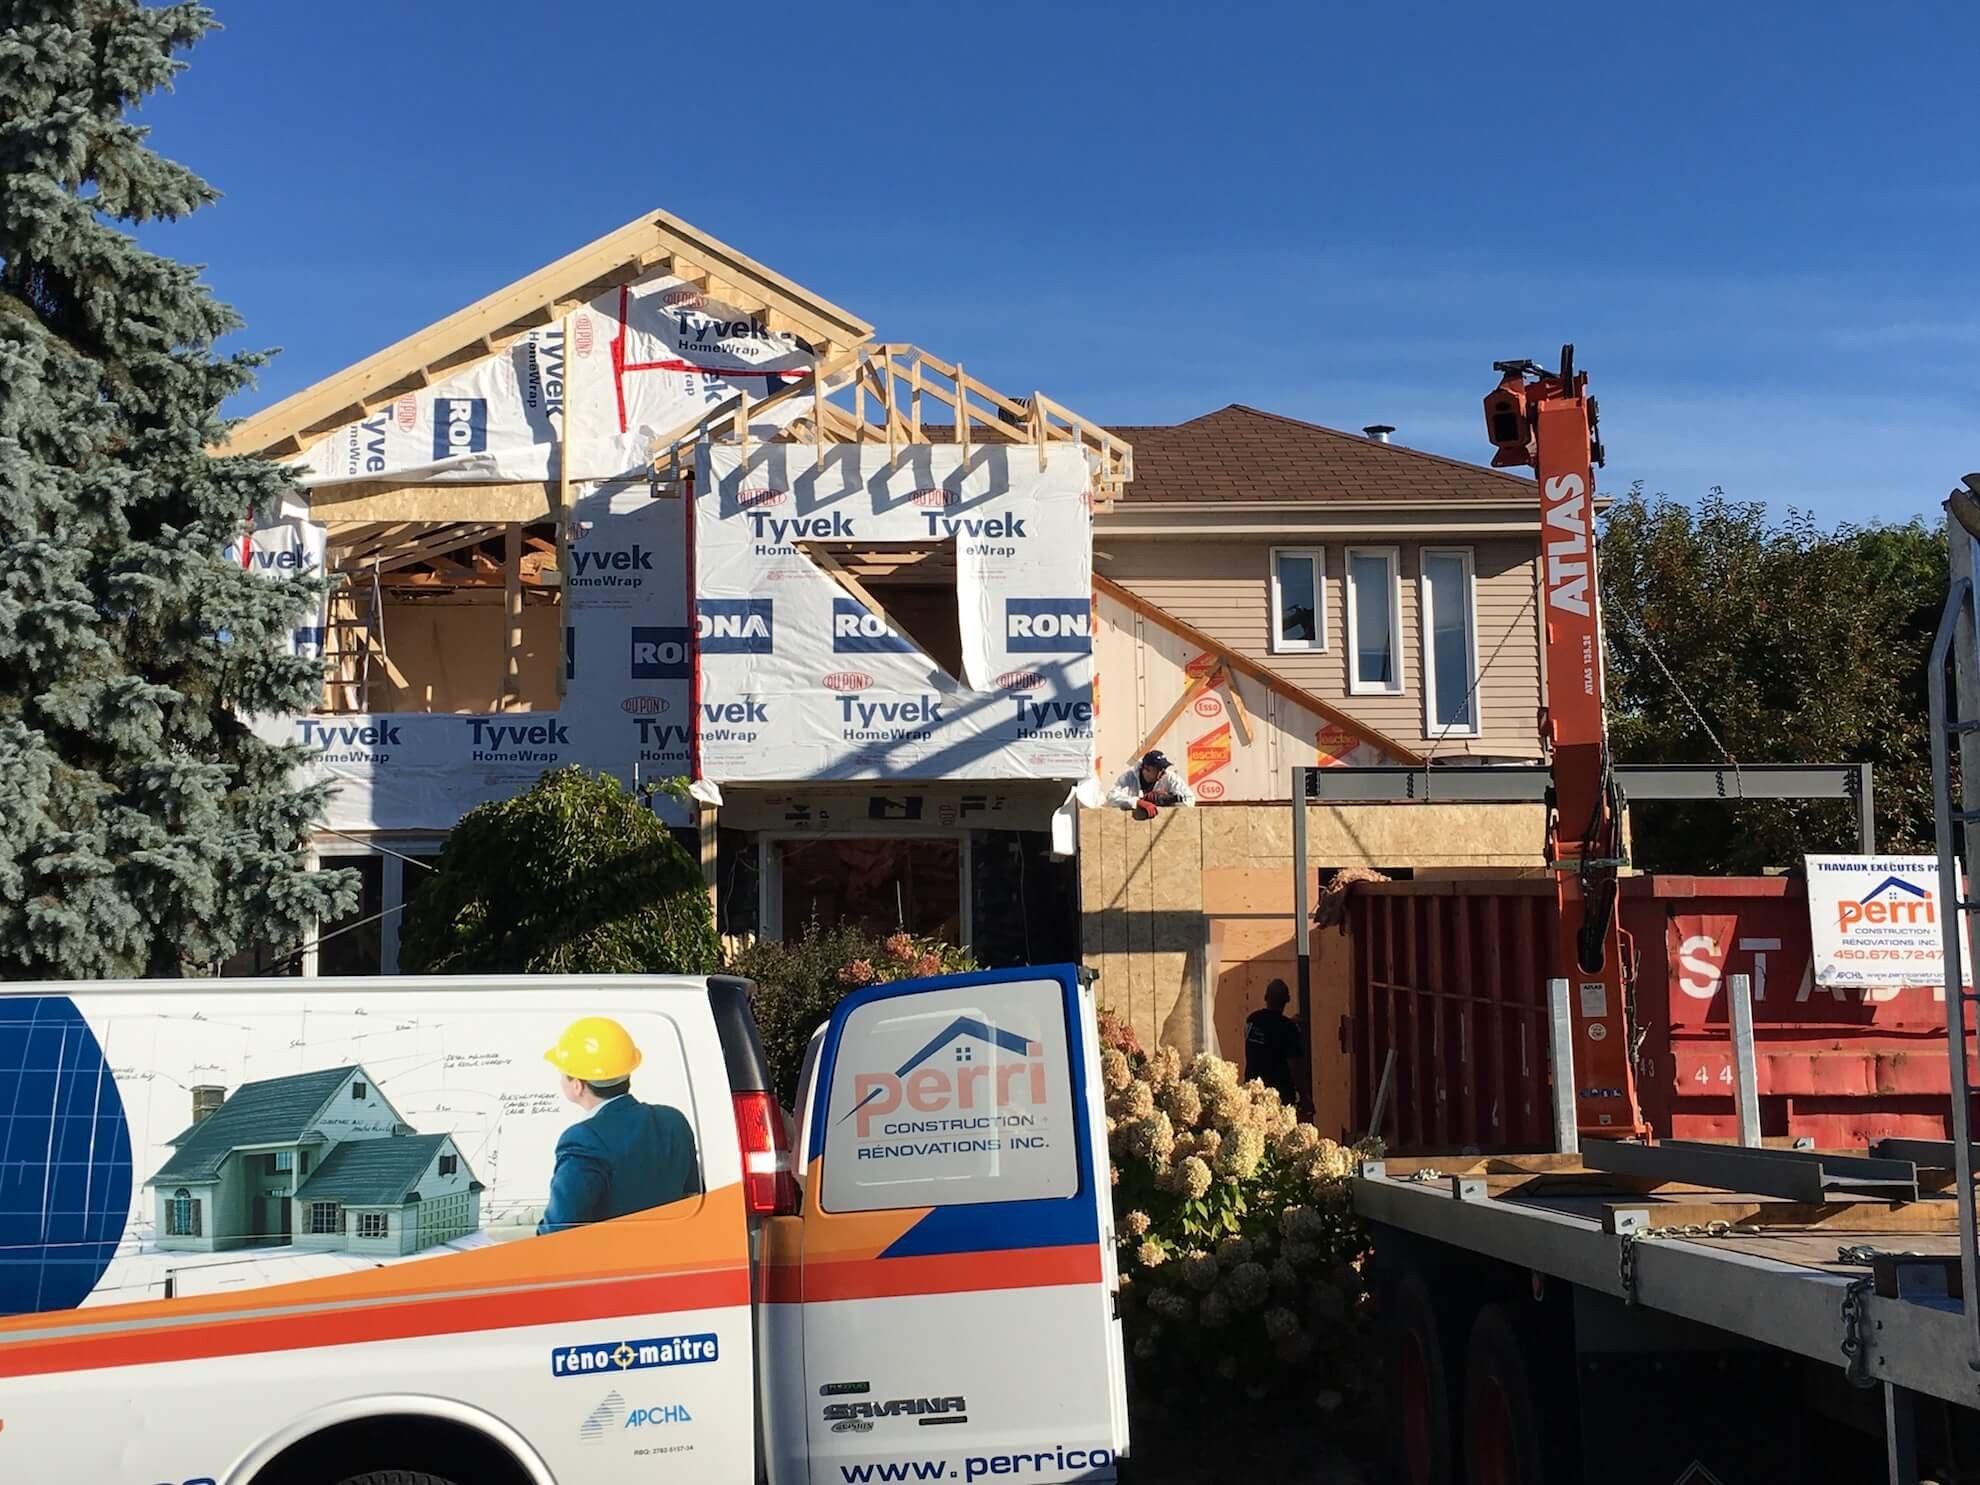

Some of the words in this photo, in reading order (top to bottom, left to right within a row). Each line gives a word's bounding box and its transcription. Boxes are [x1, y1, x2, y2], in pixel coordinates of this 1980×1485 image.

[674, 310, 769, 342] Tyvek
[678, 340, 760, 357] HomeWrap
[527, 331, 541, 408] HomeWrap
[361, 404, 393, 472] Tyve
[448, 400, 472, 456] RO
[349, 425, 361, 475] meWra
[747, 511, 855, 544] Tyvek
[921, 511, 1027, 538] Tyvek
[248, 543, 317, 569] vek
[966, 545, 1016, 558] eWrap
[1545, 472, 1590, 617] ATLAS
[568, 544, 653, 576] yvek
[696, 614, 770, 638] ONA
[835, 614, 898, 638] RO
[1008, 614, 1092, 638] RON
[633, 641, 689, 664] RO
[825, 673, 872, 690] DUPONT
[998, 673, 1045, 690] DUPONT
[623, 698, 667, 713] DUPONT
[700, 695, 768, 723] vek
[835, 694, 944, 729] Tyvek
[1009, 694, 1092, 729] Tyve
[1197, 700, 1219, 714] Esso
[296, 719, 401, 750] Tyvek
[466, 718, 570, 751] Tyvek
[633, 718, 690, 750] Tyv
[843, 728, 932, 742] HomeWrap
[1016, 727, 1093, 740] HomeWra
[316, 751, 390, 765] omeWrap
[473, 750, 558, 763] HomeWrap
[1200, 783, 1221, 797] Esso
[1817, 863, 1868, 872] TRAVAUX
[1927, 863, 1940, 873] PA
[1838, 891, 1935, 933] perri
[1854, 927, 1931, 935] CONSTRUCTION
[1833, 949, 1944, 960] 450.676.7247
[853, 1041, 1047, 1138] perri
[884, 1114, 1035, 1136] CONSTRUCTION
[858, 1139, 1001, 1160] RÉNOVATIONS
[1010, 1136, 1050, 1150] INC.
[555, 1347, 609, 1373] réno
[639, 1337, 716, 1364] maître
[840, 1445, 1116, 1484] www.perrico
